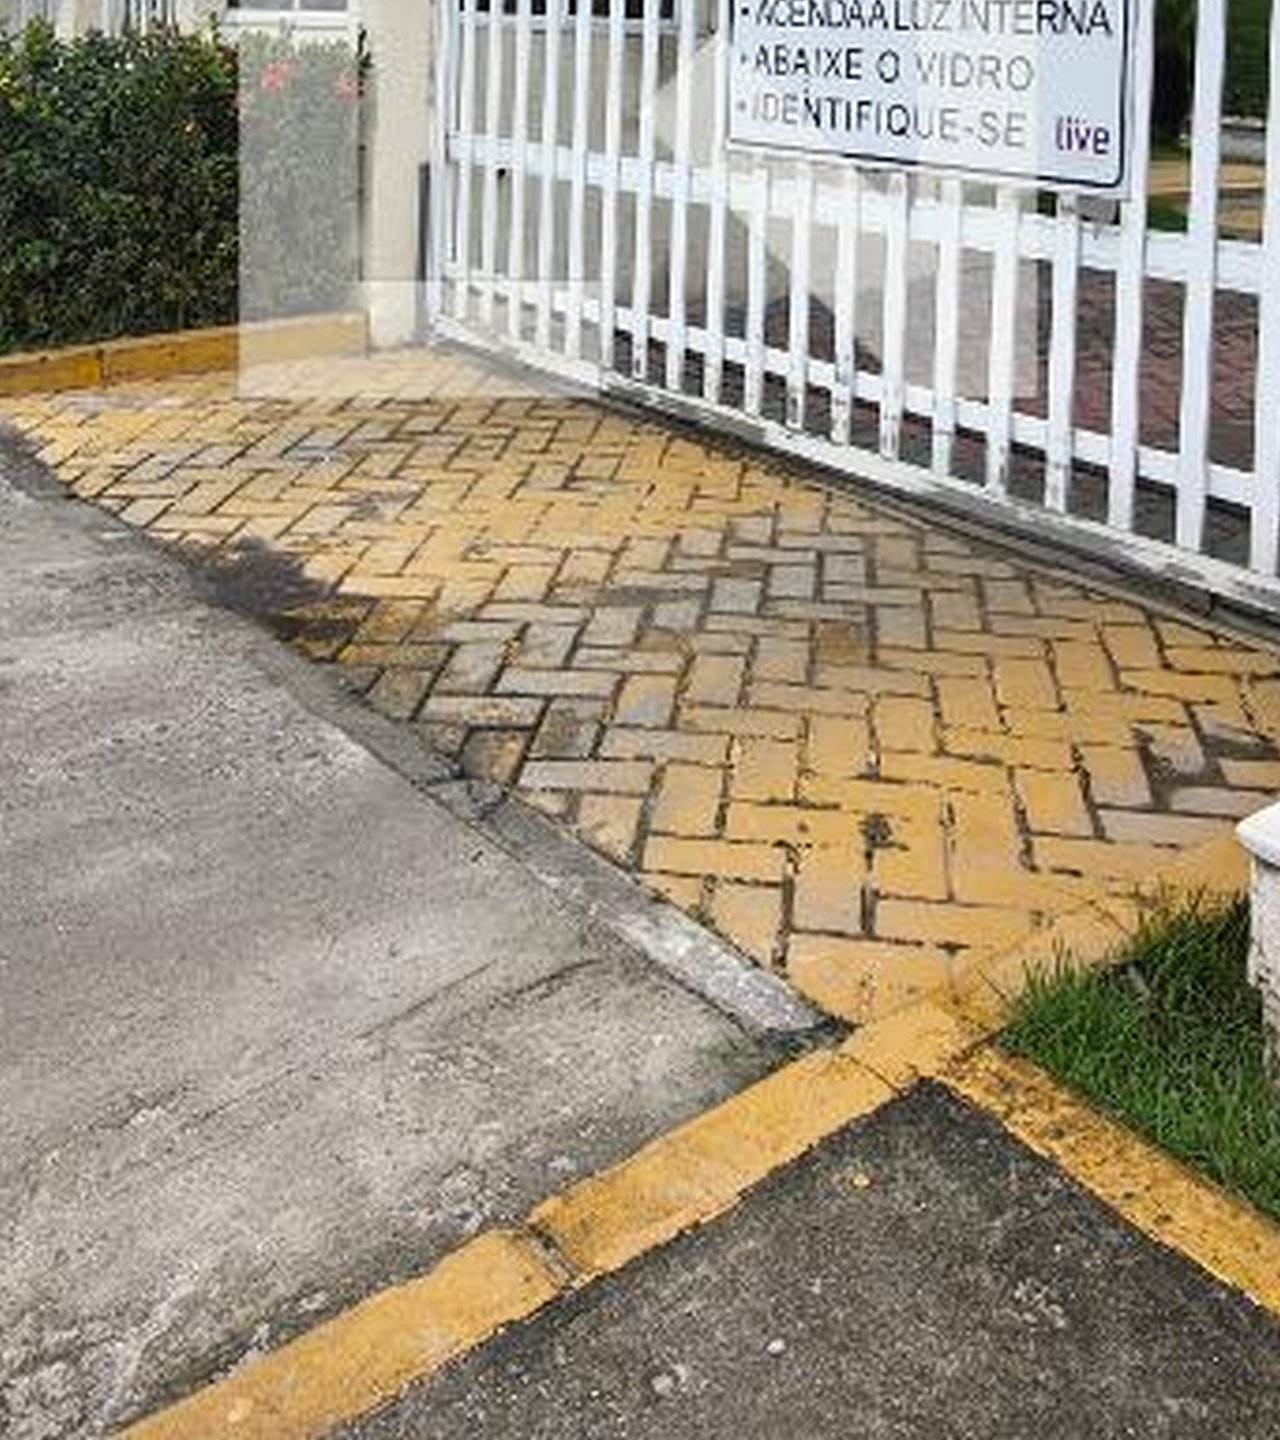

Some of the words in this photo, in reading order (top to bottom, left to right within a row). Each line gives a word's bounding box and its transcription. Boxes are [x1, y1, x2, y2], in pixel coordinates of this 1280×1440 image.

[754, 44, 863, 80] ABAIXE
[876, 50, 901, 83] O
[914, 51, 1035, 91] VIDRO
[751, 92, 1027, 148] IDENTIFIQUE-SE
[1055, 116, 1110, 155] live
